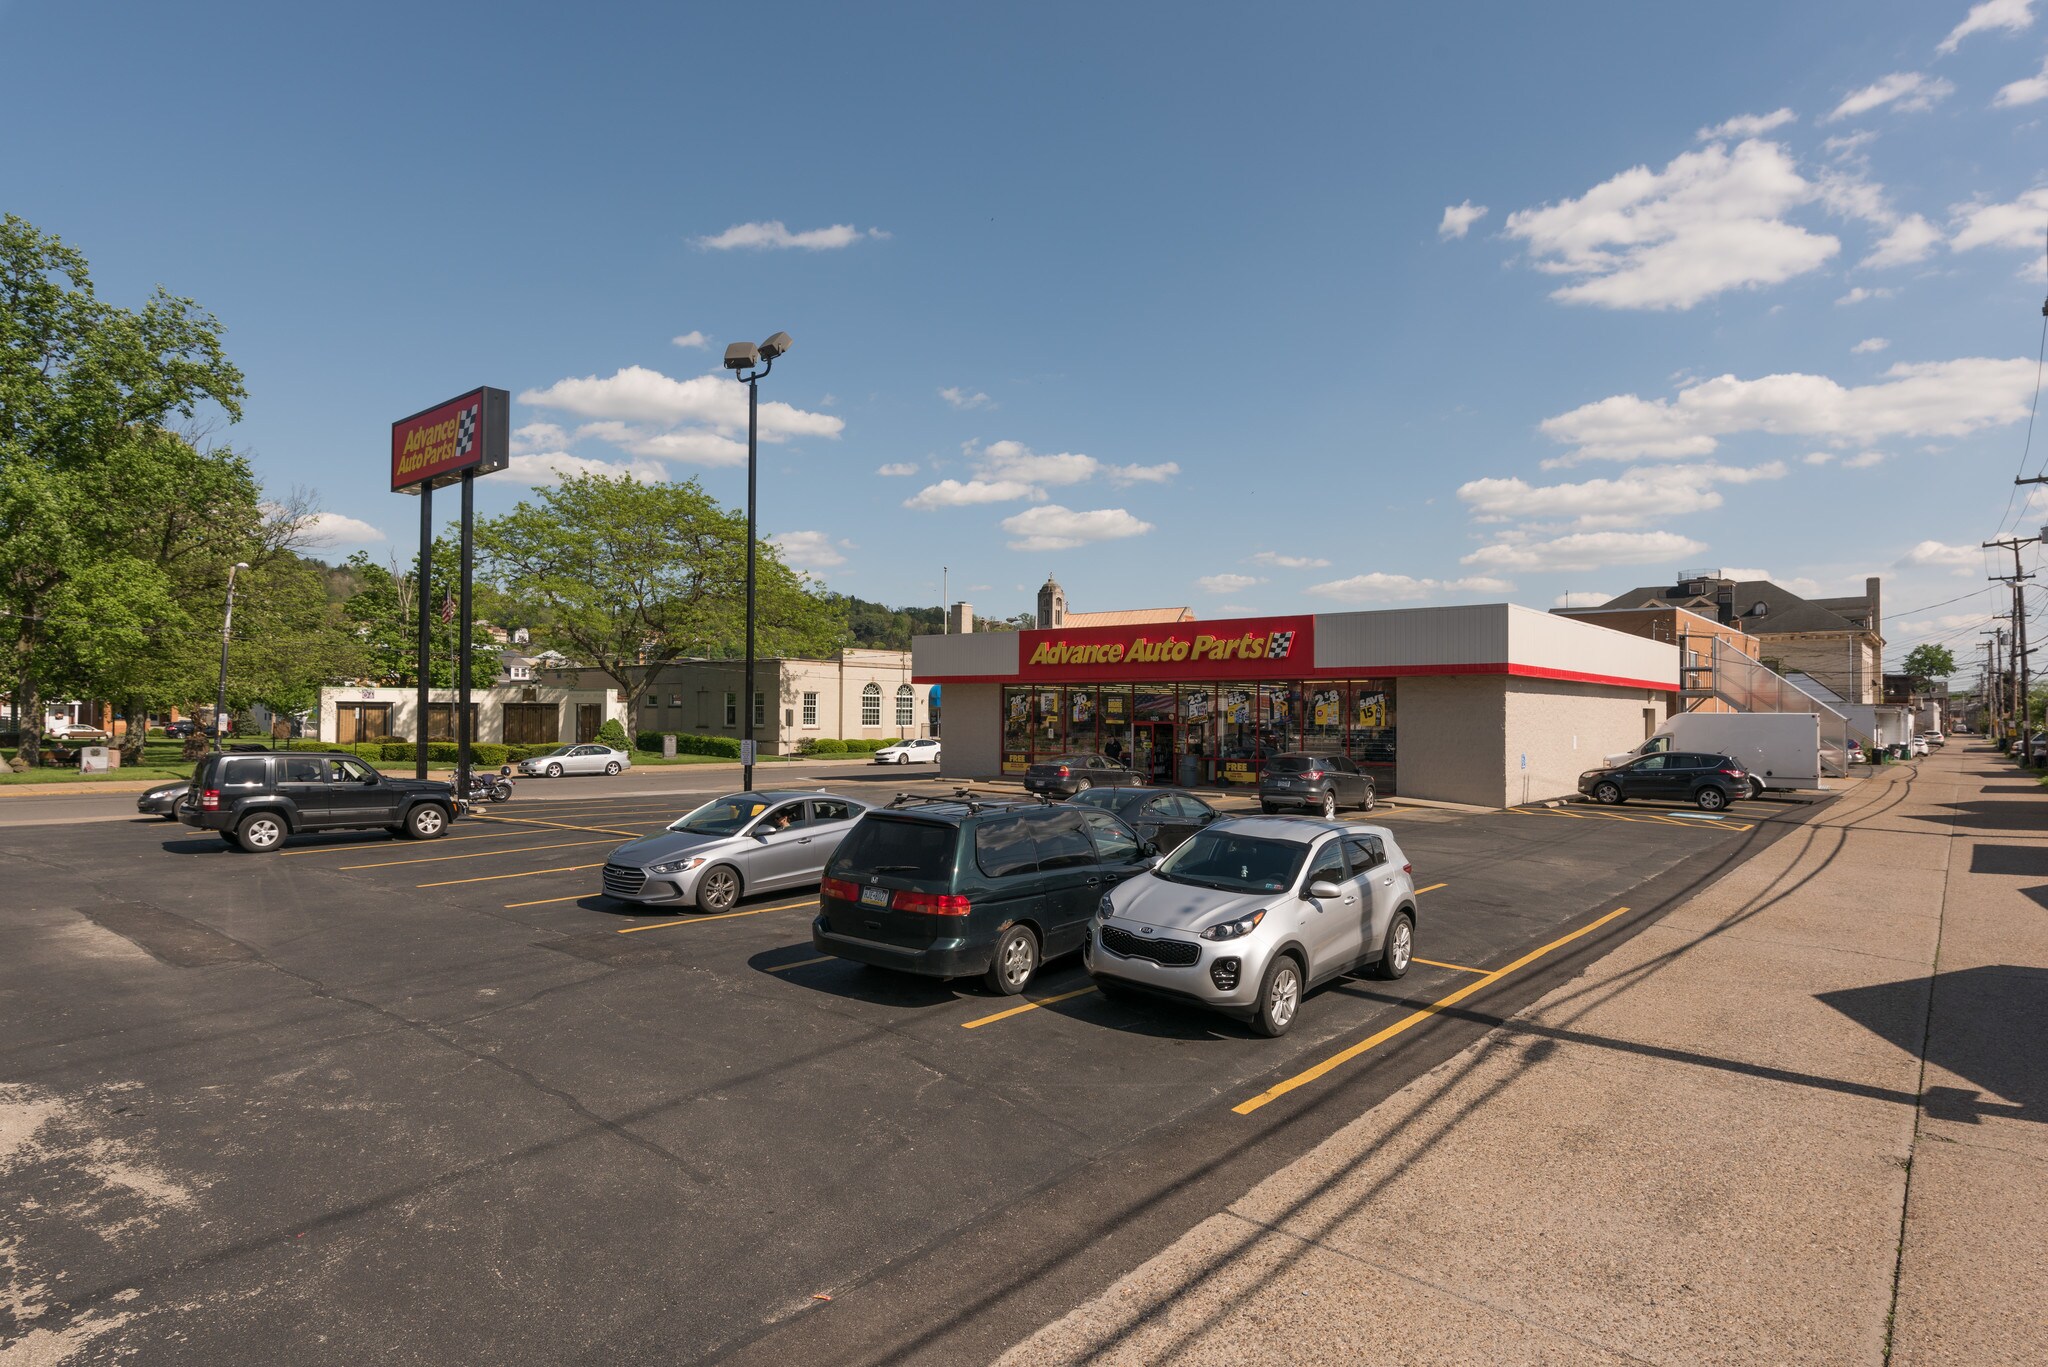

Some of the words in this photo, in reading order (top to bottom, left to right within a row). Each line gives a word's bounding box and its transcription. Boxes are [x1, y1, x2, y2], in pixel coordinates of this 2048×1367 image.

[403, 418, 455, 455] Advance
[397, 451, 424, 476] Auto
[423, 441, 453, 467] Parts
[1029, 641, 1123, 665] Advance
[1123, 637, 1190, 663] Auto
[1190, 633, 1265, 661] Parts
[1360, 694, 1385, 708] SAVE
[1226, 762, 1247, 771] FREE
